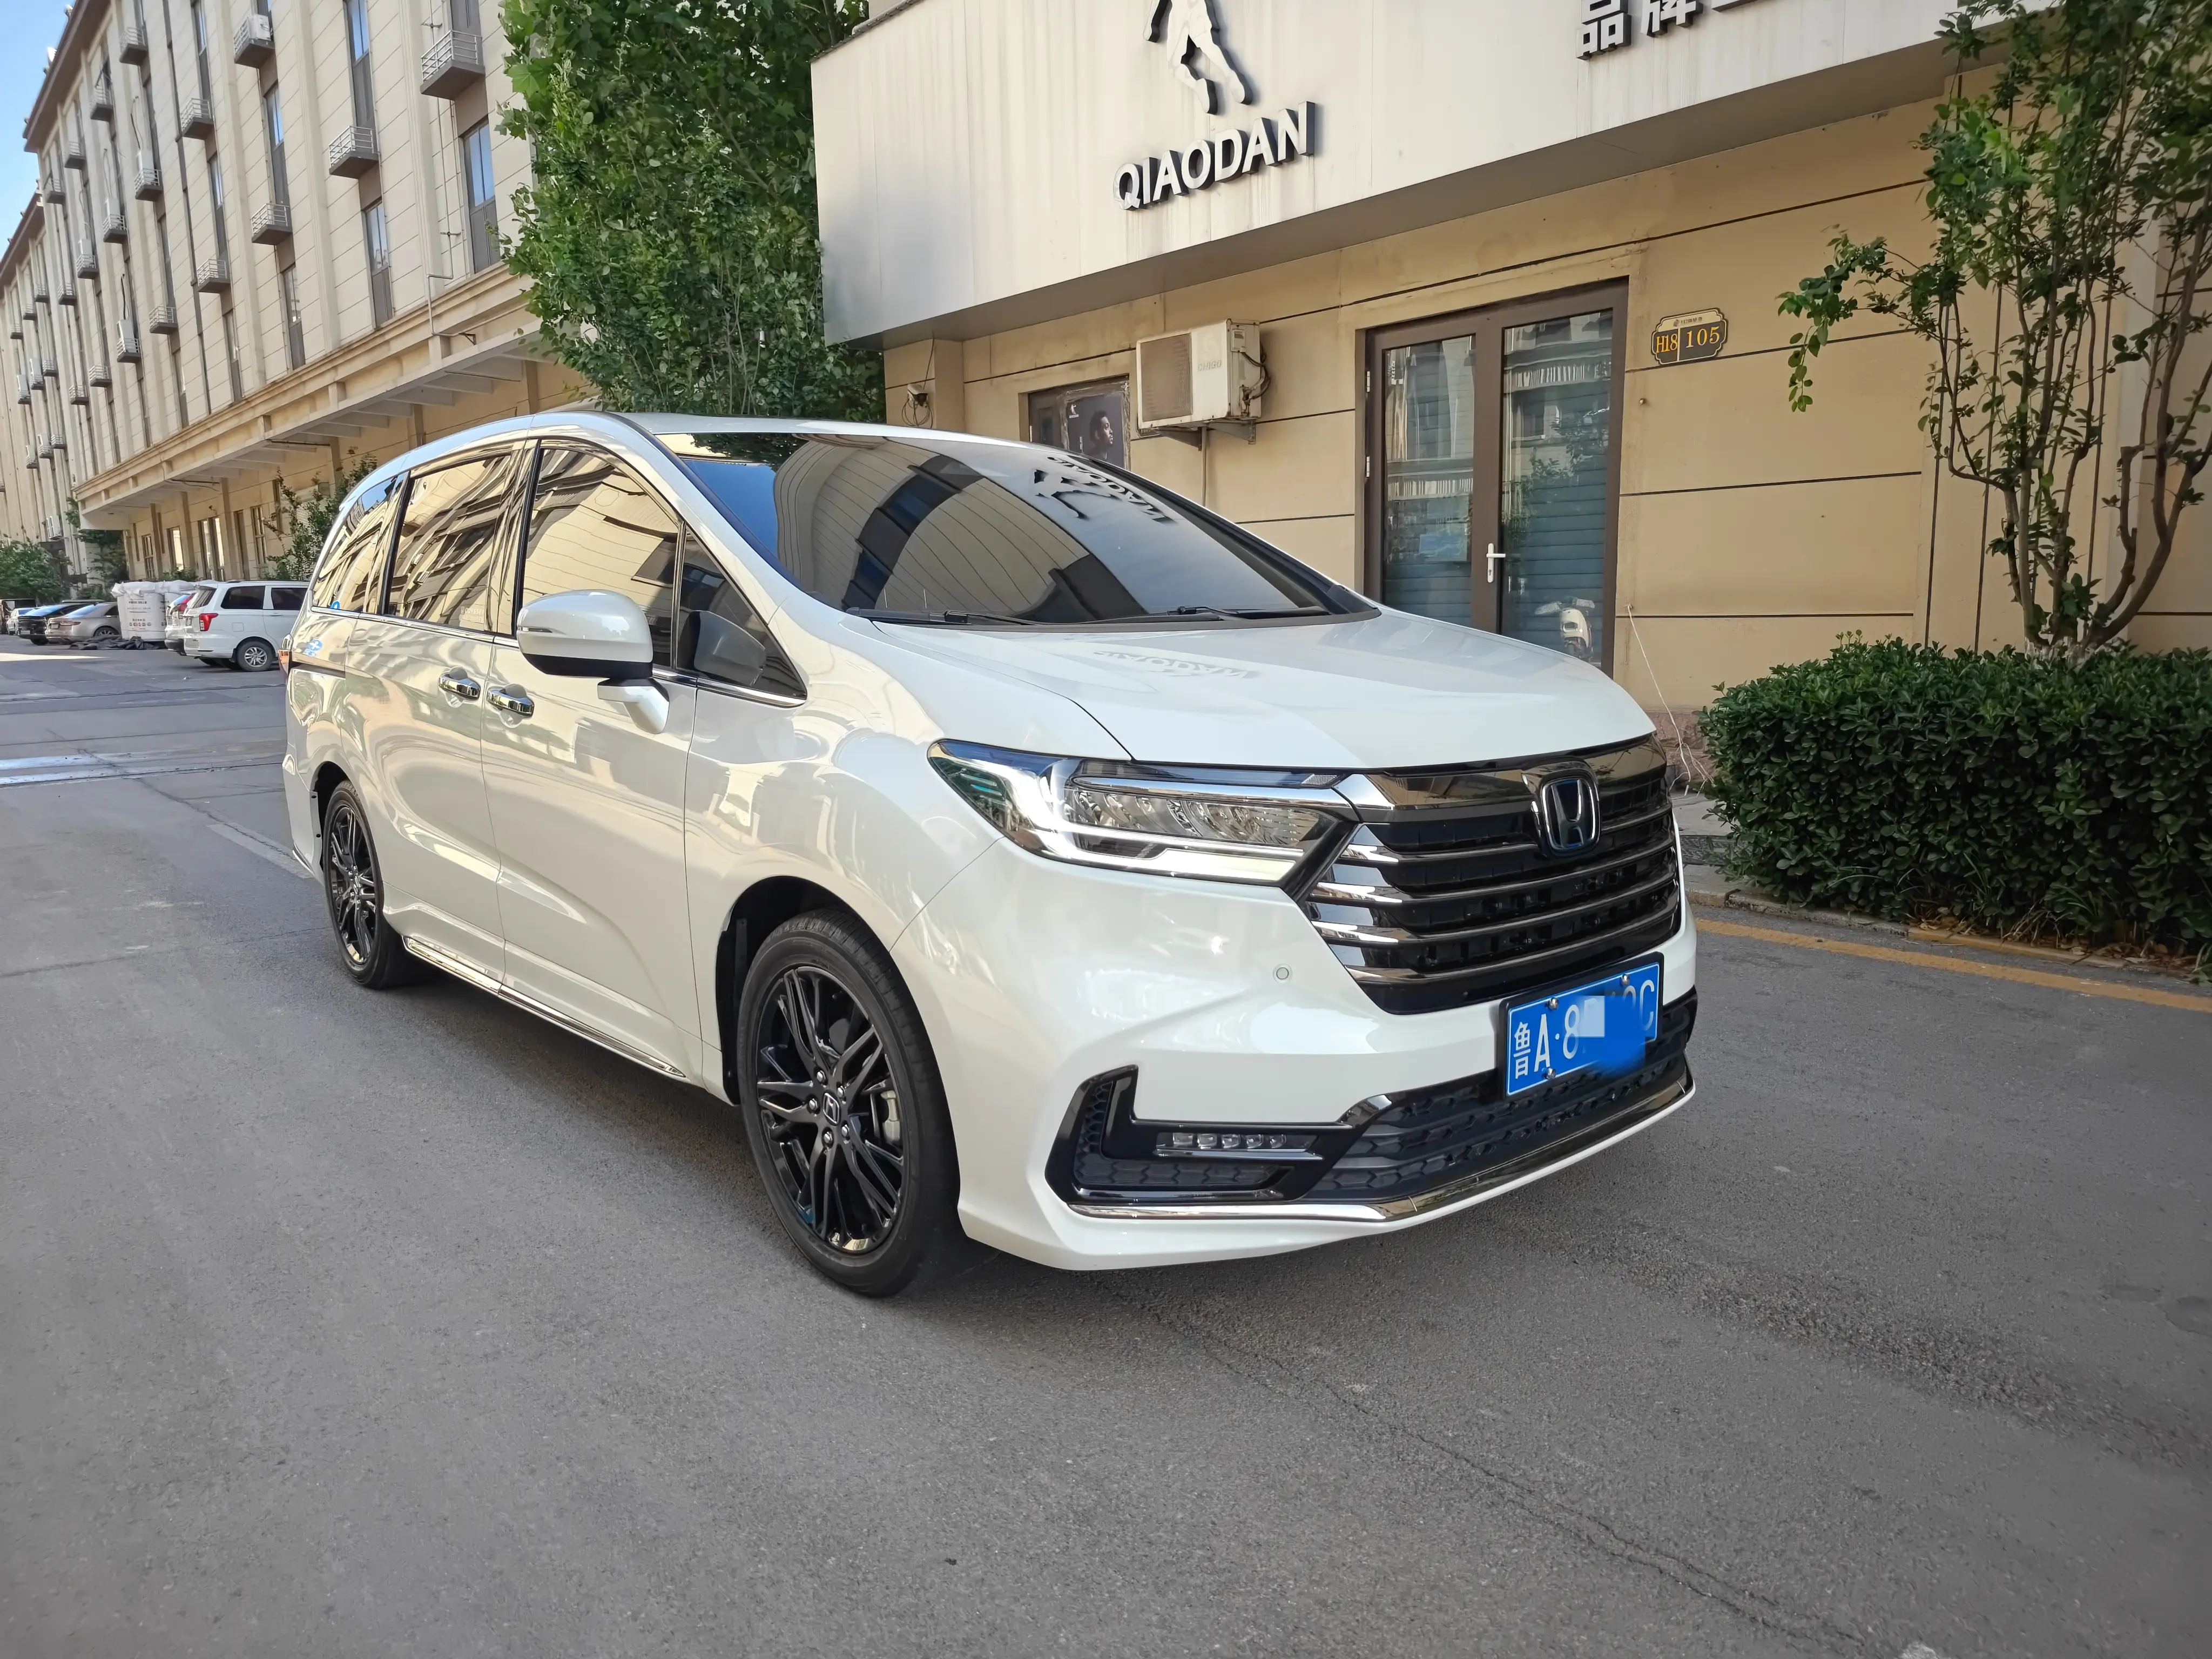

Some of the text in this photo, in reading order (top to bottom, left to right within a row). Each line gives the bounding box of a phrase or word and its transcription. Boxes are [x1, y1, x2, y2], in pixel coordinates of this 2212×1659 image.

[1113, 101, 1314, 210] QIAODAN
[1198, 360, 1222, 372] CHIGO
[1656, 326, 1720, 353] H18 105
[1514, 980, 1655, 1079] 鲁A·8C
